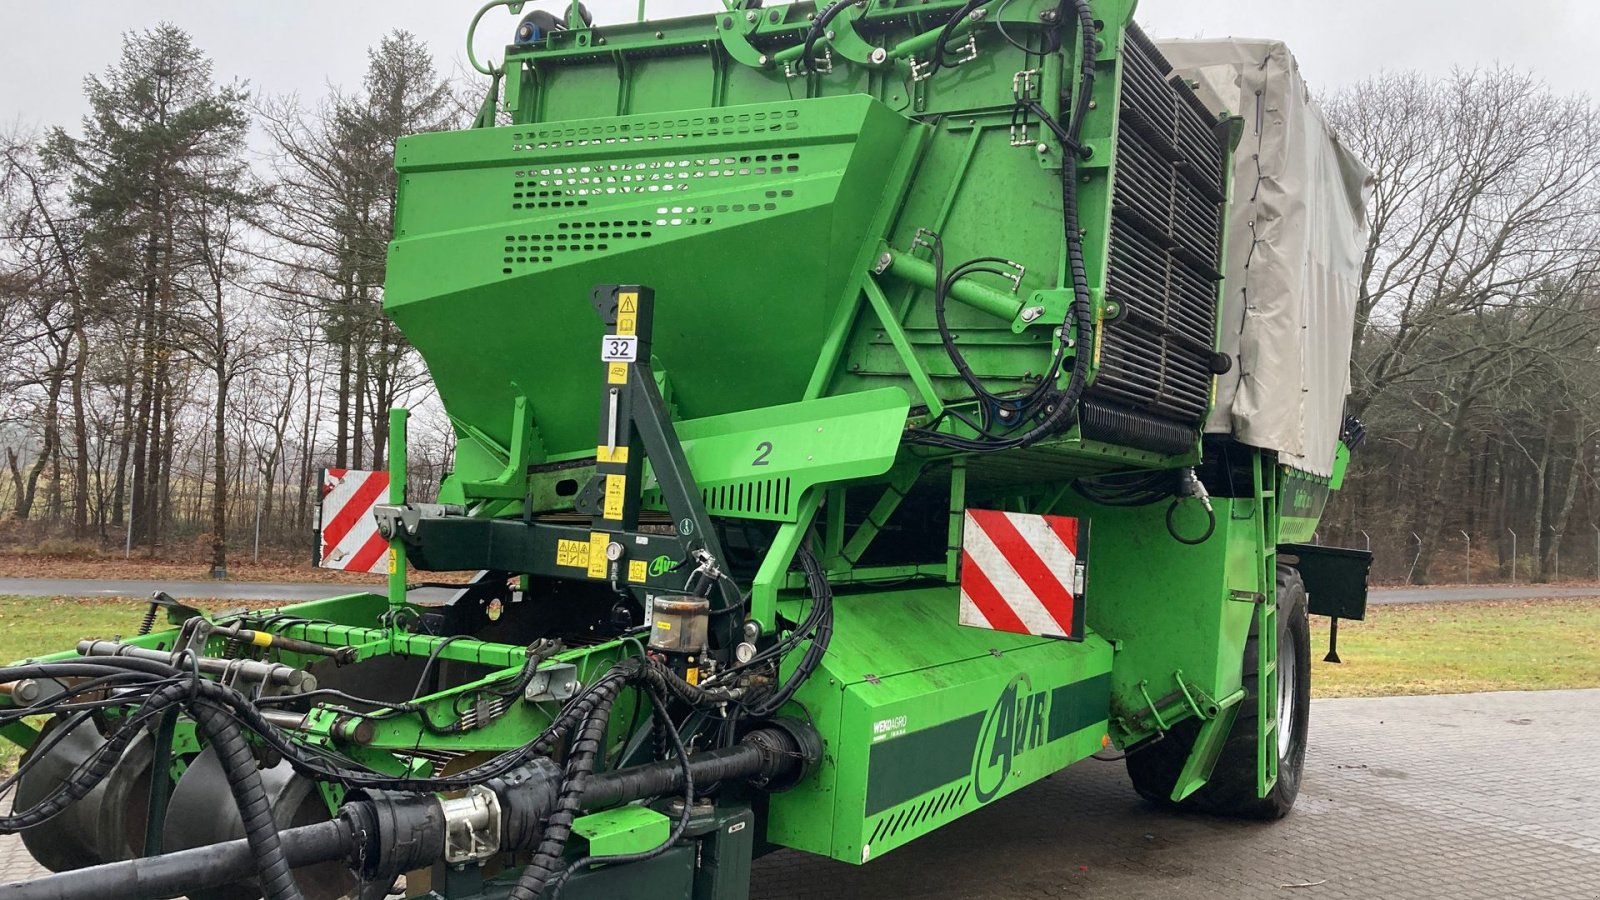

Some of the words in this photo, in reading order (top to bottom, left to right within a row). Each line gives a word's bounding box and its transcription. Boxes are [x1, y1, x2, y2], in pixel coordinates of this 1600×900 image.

[610, 341, 629, 356] 32
[752, 442, 773, 466] 2
[975, 674, 1048, 800] AVR
